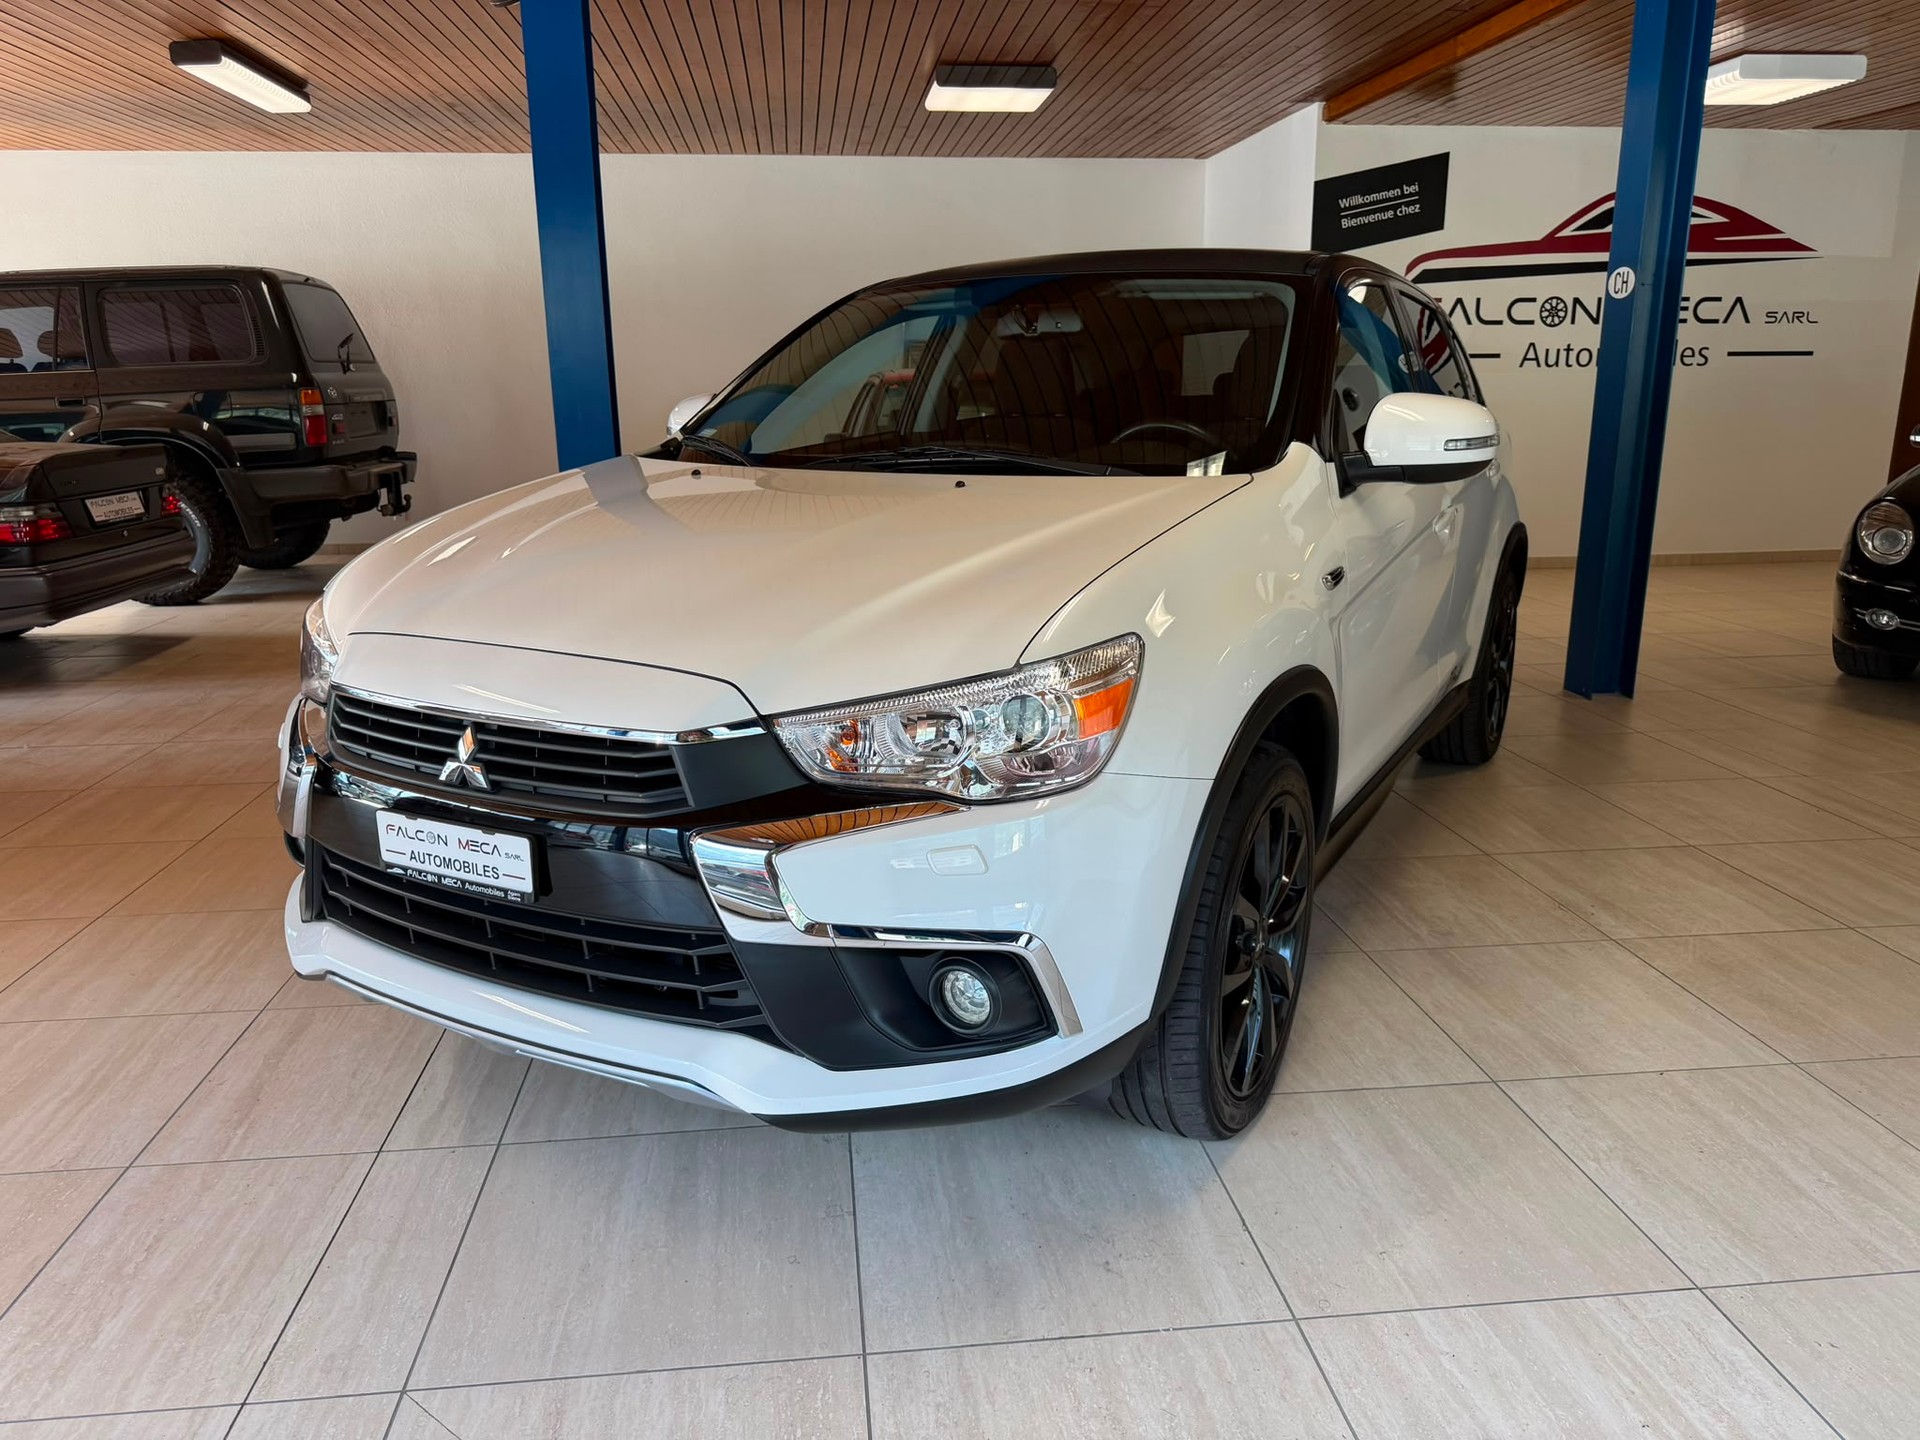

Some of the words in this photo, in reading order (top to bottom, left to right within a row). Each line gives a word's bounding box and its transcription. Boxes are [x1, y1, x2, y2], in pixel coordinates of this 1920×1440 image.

[1338, 187, 1401, 209] Willkommen
[1403, 182, 1419, 195] bei
[1341, 210, 1394, 229] Bienvenue
[1396, 204, 1421, 216] chez
[1613, 271, 1630, 295] CH
[1433, 296, 1603, 327] ALCON
[1764, 311, 1819, 324] SARL
[385, 823, 448, 847] FALCON
[457, 837, 502, 858] MECA
[409, 850, 500, 880] AUTOMOBILES
[407, 869, 438, 883] FALCON
[441, 877, 462, 889] MECA
[465, 882, 505, 898] Automobiles
